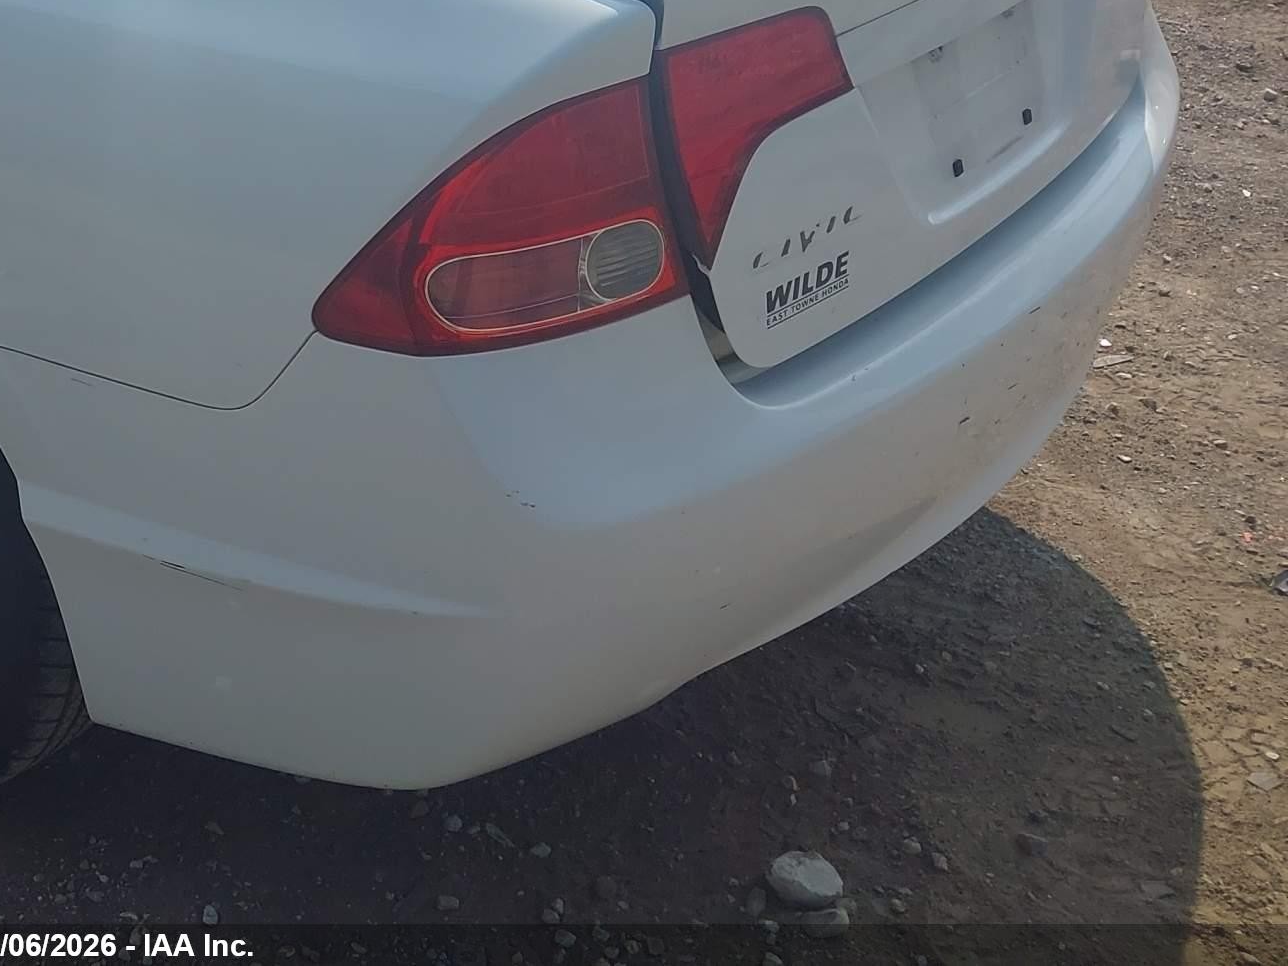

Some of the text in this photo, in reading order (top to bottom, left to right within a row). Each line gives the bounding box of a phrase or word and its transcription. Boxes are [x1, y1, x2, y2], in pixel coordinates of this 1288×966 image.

[766, 250, 850, 314] WILDE
[766, 277, 850, 327] EAST TOWNE HONDA
